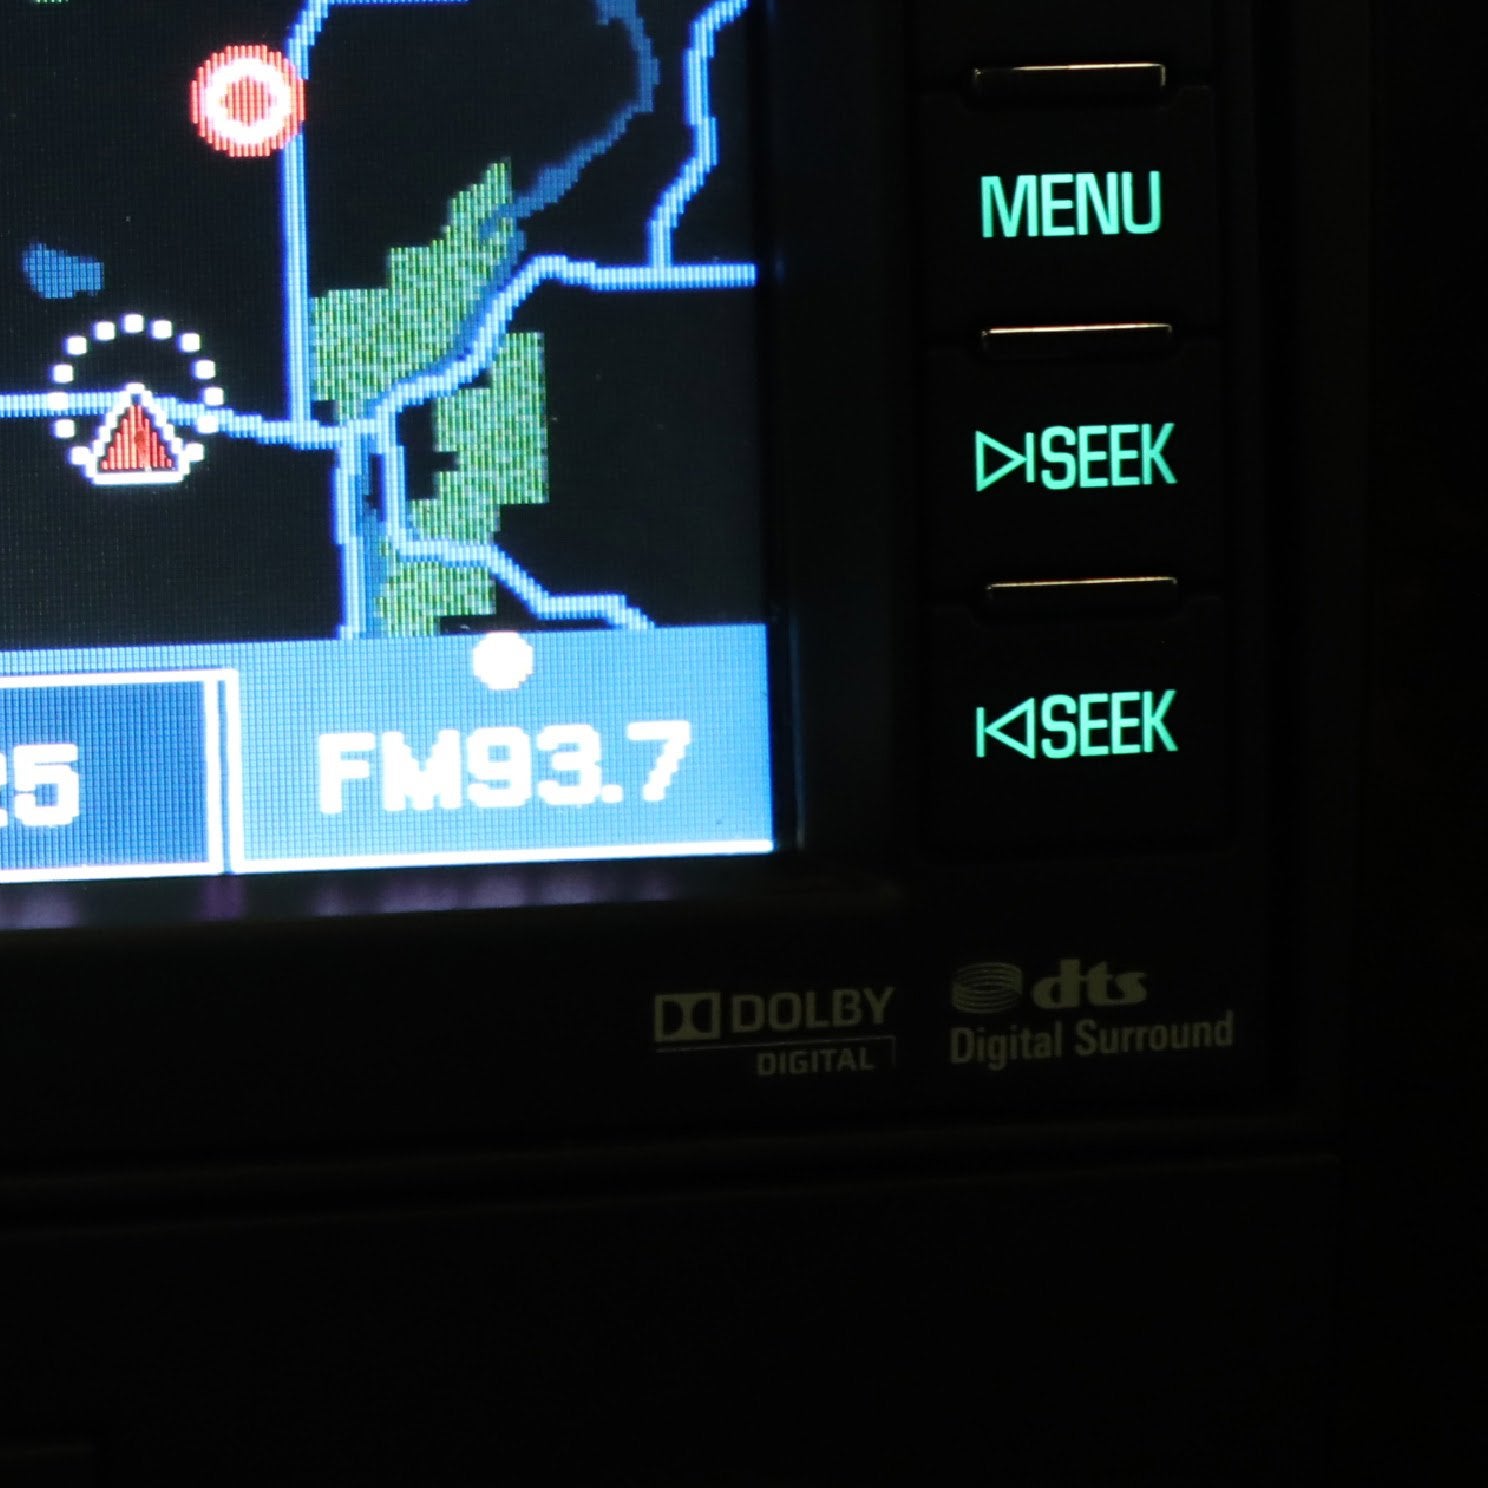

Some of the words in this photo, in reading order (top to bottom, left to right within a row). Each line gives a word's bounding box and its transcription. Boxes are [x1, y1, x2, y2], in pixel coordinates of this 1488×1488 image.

[981, 170, 1161, 238] MENU
[1040, 423, 1176, 490] SEEK
[1040, 690, 1177, 759] SEEK
[320, 722, 689, 812] FM93.7
[727, 986, 896, 1034] DOLBY
[1031, 957, 1148, 1010] dts
[755, 1042, 876, 1077] DIGITAL
[950, 1018, 1063, 1072] Digital
[1075, 1011, 1234, 1059] Surround
